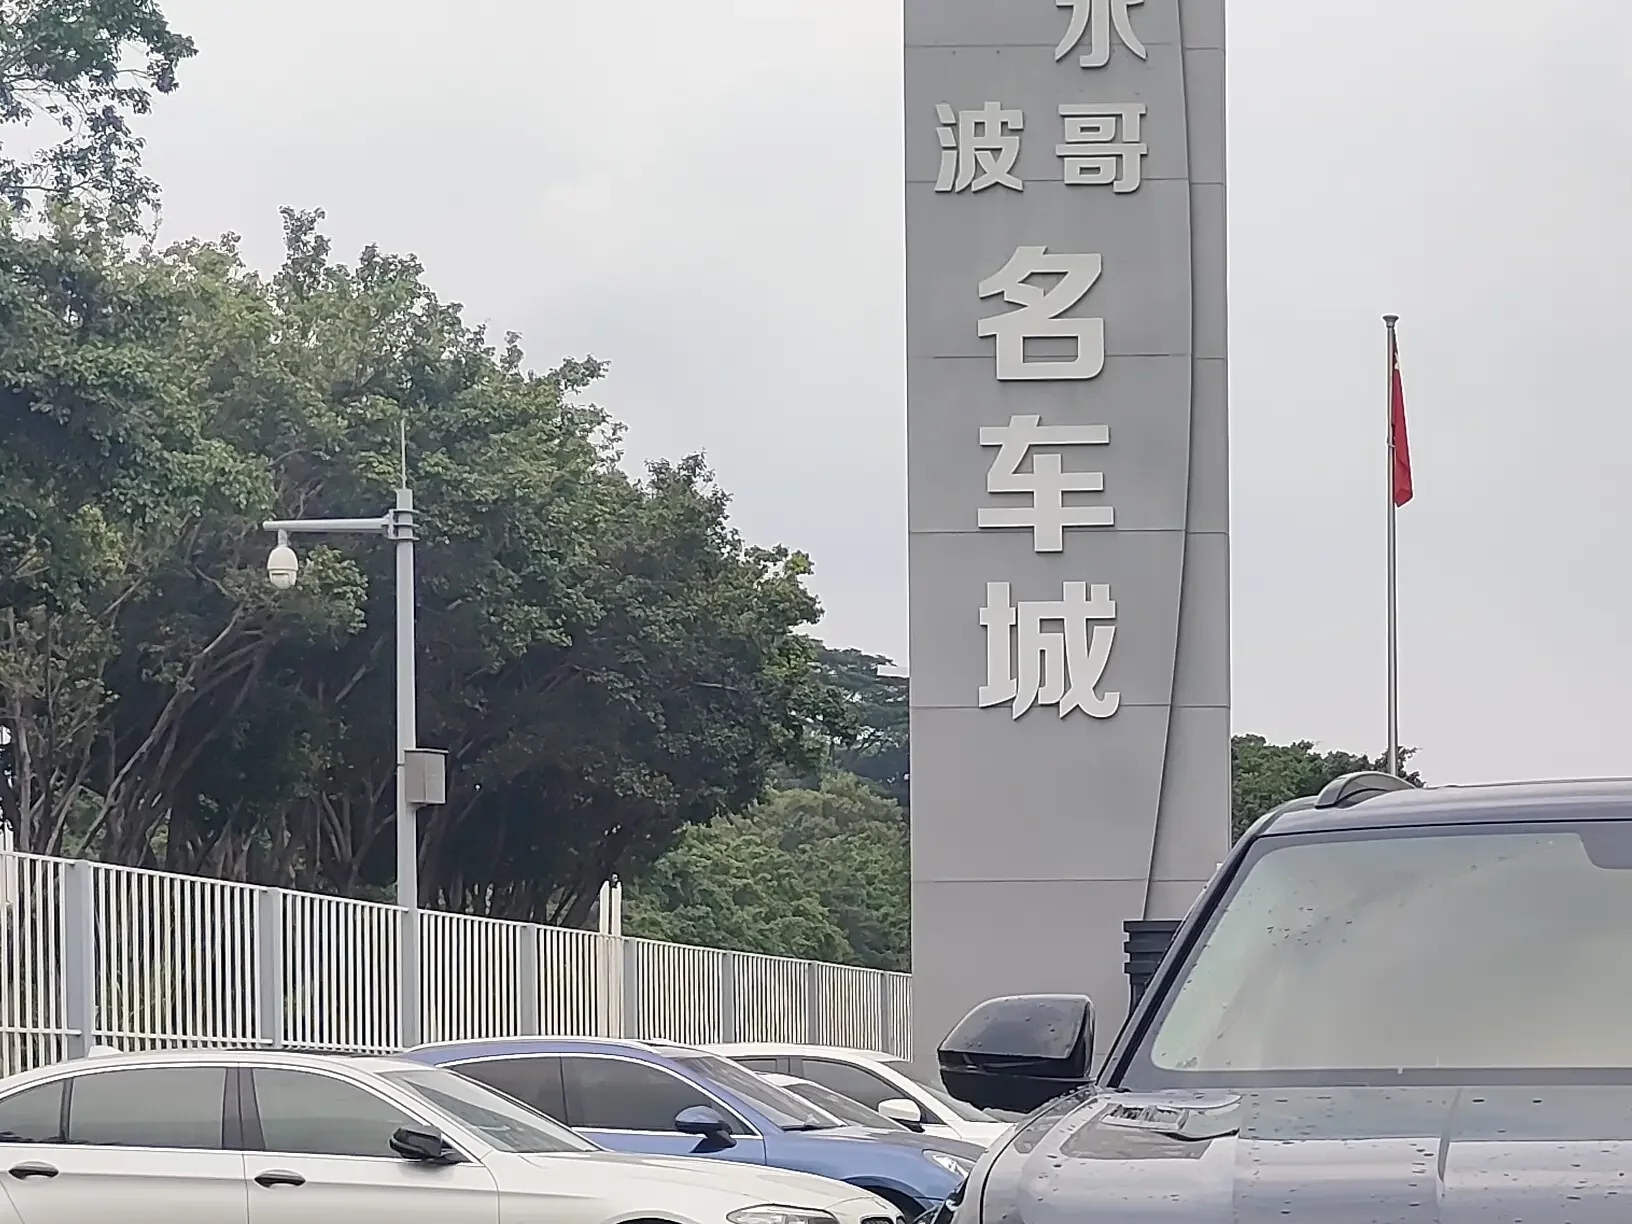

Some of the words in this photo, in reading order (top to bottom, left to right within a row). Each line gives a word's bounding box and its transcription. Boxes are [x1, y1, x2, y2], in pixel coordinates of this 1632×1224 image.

[933, 100, 1149, 194] 波哥
[976, 245, 1121, 721] 名车城
